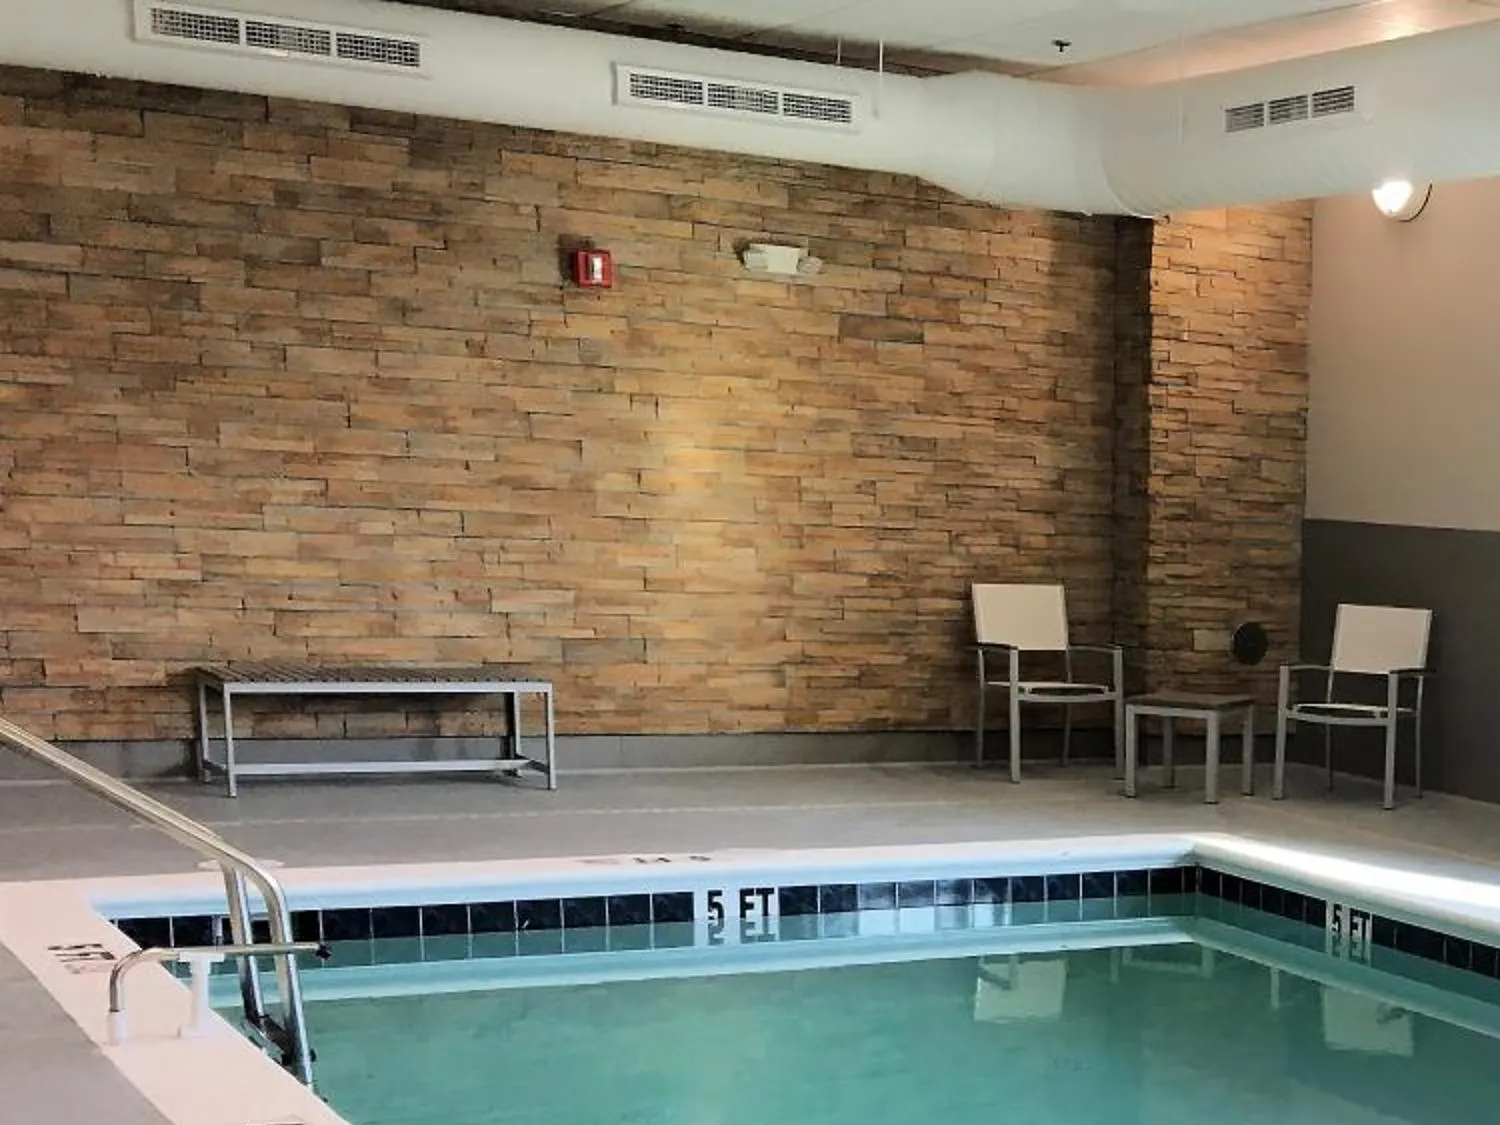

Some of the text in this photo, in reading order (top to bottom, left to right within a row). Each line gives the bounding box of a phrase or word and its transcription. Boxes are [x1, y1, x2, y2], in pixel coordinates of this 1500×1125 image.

[707, 887, 775, 920] 5 FT
[1331, 903, 1371, 941] 5 FT
